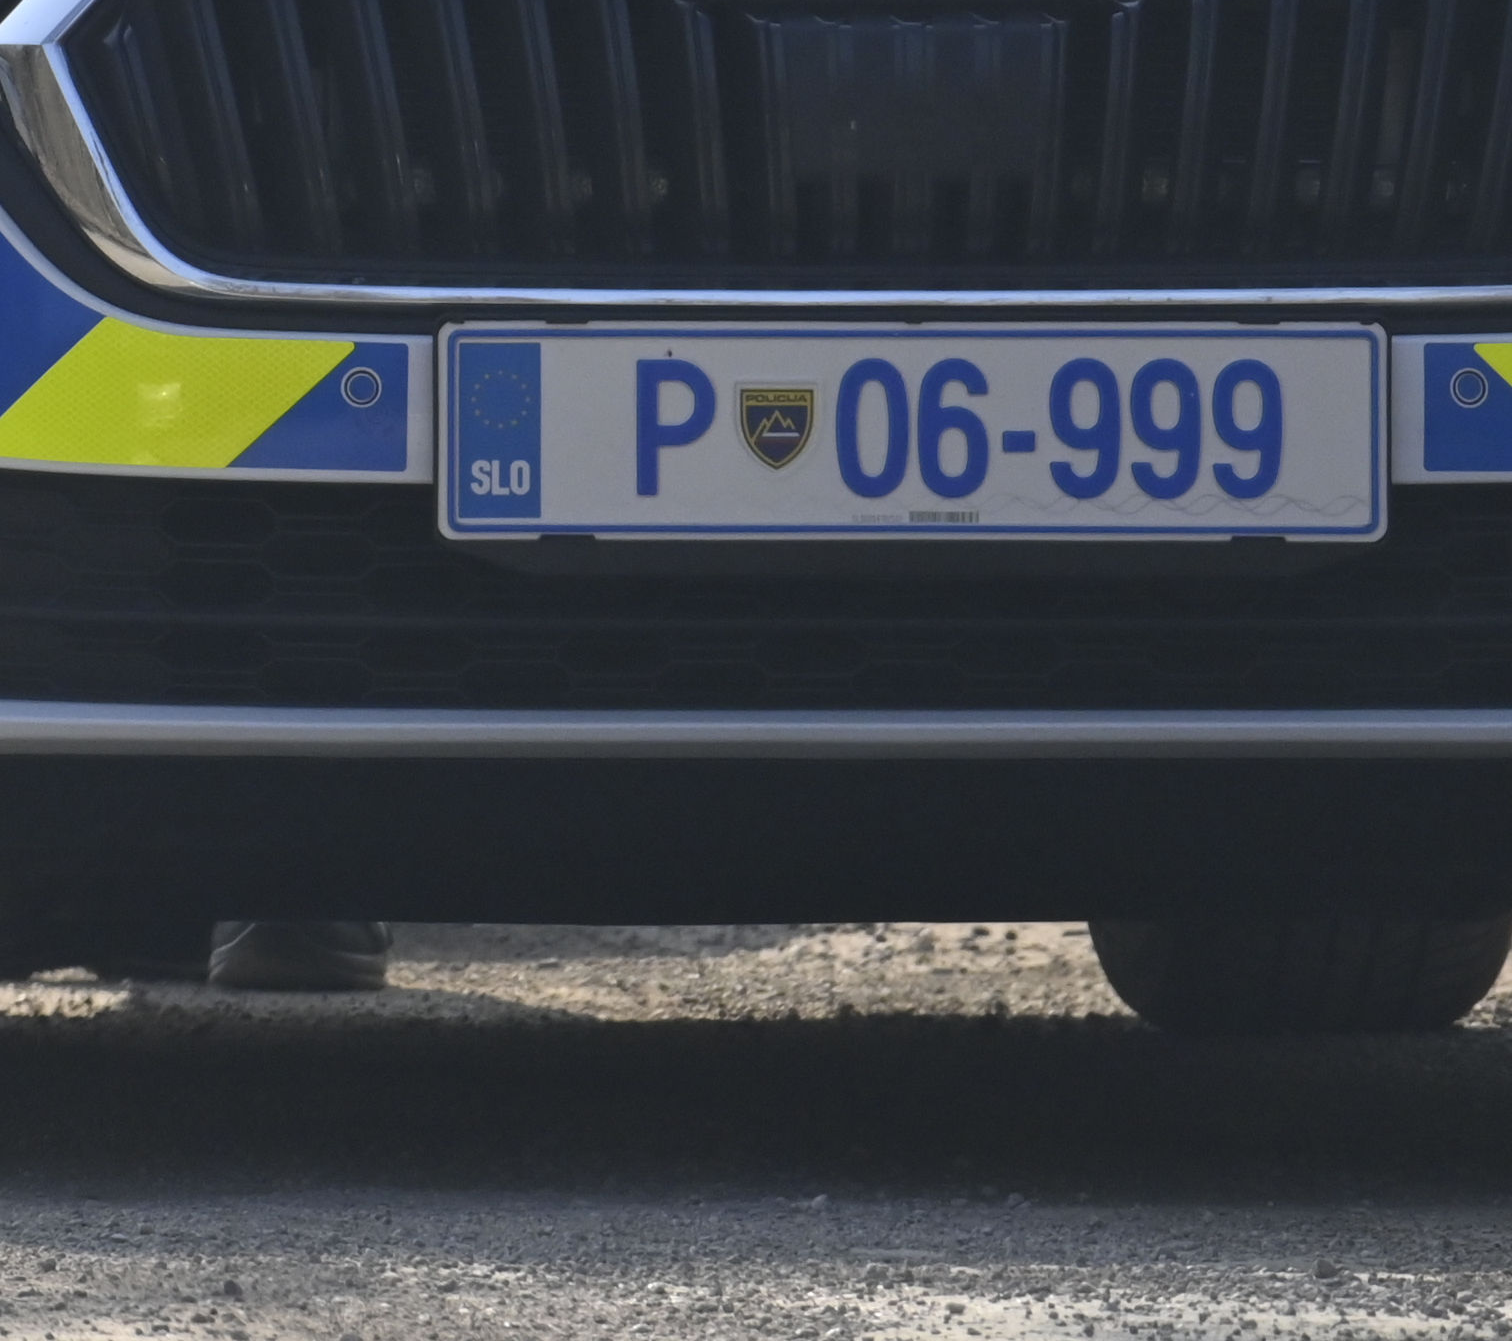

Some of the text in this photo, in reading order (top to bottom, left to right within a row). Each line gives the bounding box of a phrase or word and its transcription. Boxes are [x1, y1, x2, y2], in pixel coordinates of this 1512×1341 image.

[744, 393, 809, 405] POLICIJA
[636, 357, 1283, 499] P 06-999
[469, 459, 532, 496] SLO
